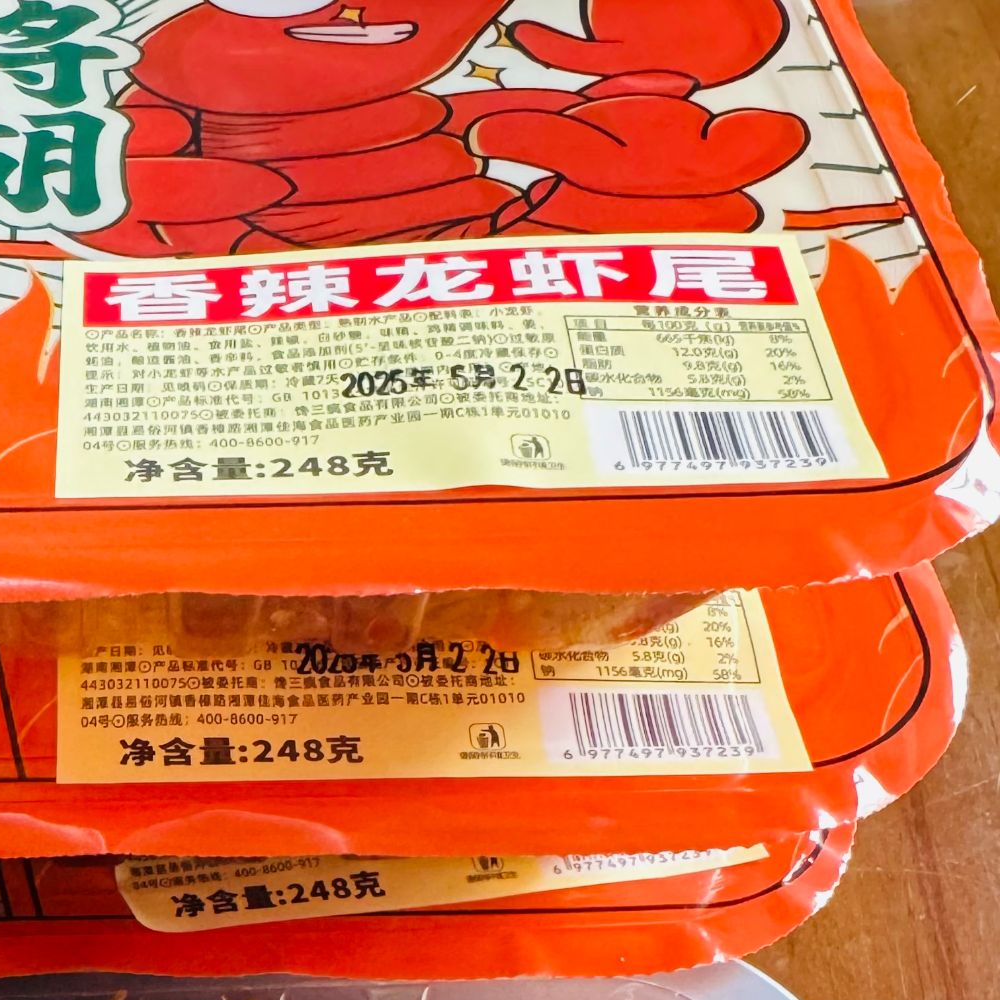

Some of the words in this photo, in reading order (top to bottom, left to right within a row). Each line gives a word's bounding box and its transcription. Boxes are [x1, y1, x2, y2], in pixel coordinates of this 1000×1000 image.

[105, 250, 768, 323] 香辣龙虾尾
[702, 620, 732, 633] 20%
[708, 636, 735, 649] 16%
[712, 667, 742, 681] 58%
[119, 735, 364, 767] 净含量:248克
[170, 871, 386, 918] 净含量:248克
